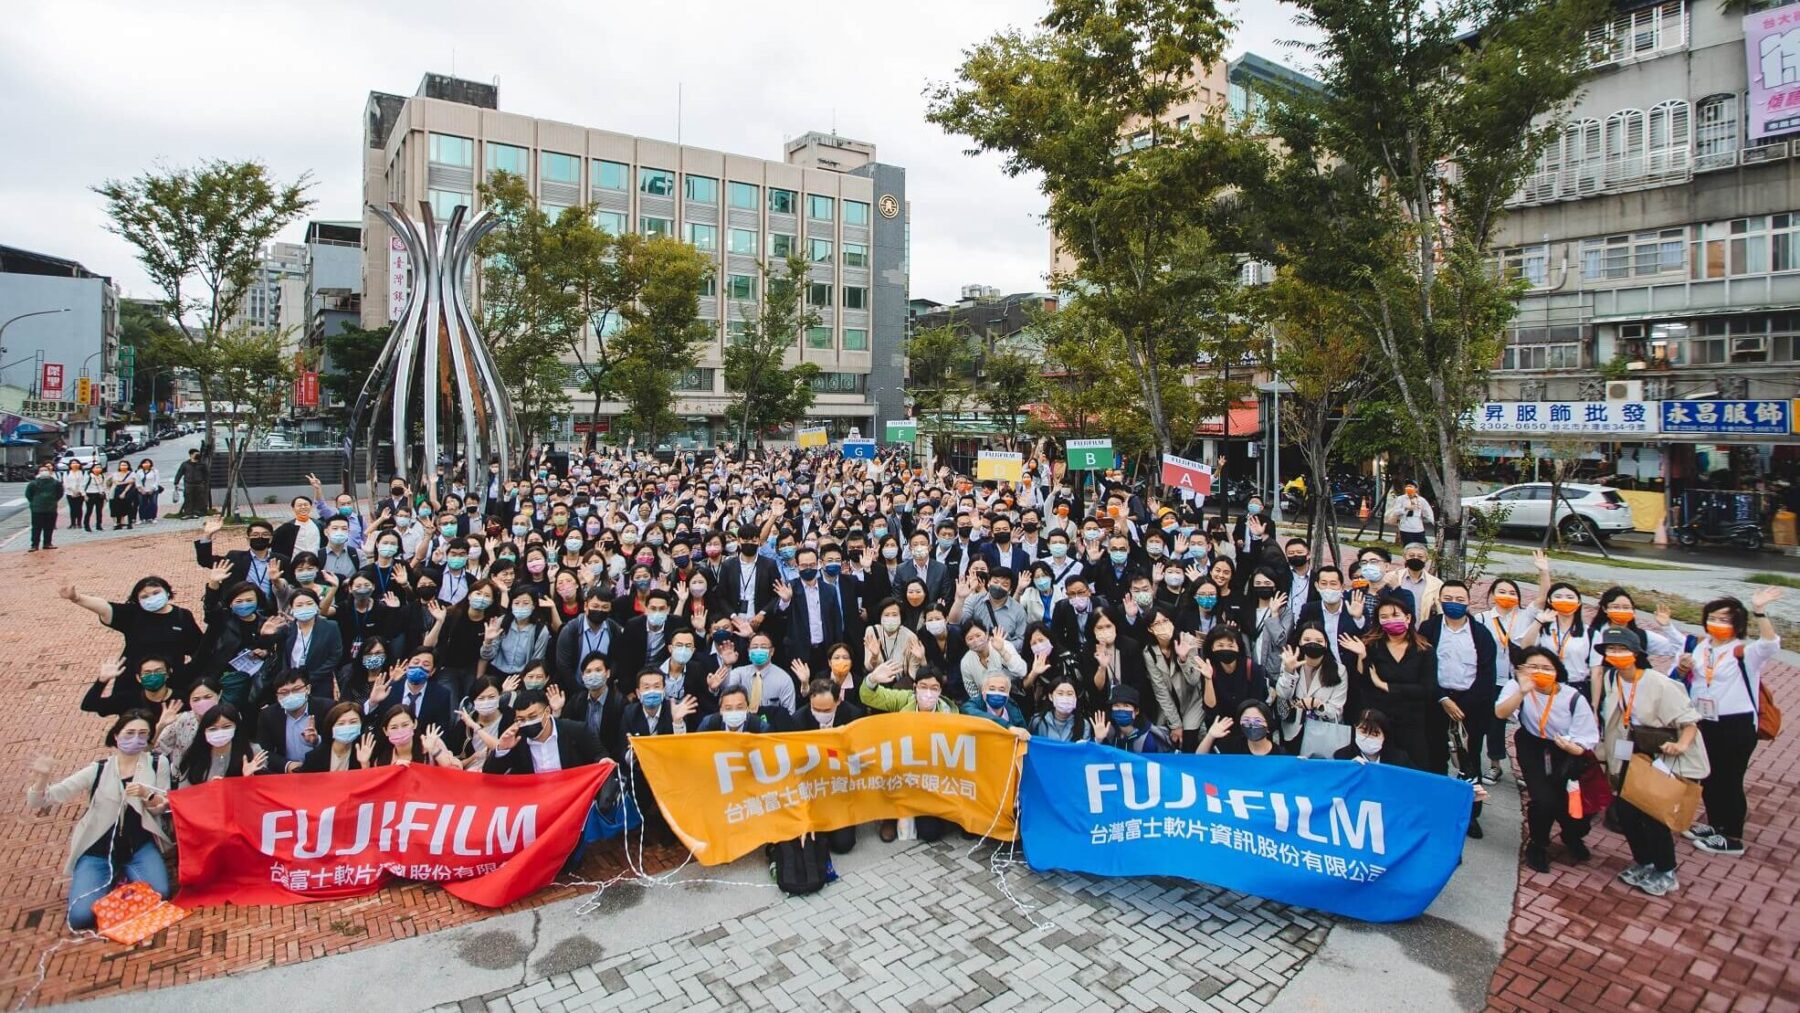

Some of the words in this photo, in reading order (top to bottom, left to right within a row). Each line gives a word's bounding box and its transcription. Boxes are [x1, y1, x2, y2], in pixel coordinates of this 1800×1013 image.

[1667, 402, 1784, 425] 永昌服飾
[898, 429, 905, 439] F
[854, 447, 864, 457] G
[1085, 452, 1097, 465] B
[1180, 472, 1193, 487] A
[714, 732, 977, 795] FUJIFILM
[1084, 762, 1386, 855] FUJIFILM
[260, 801, 539, 859] FUJIFILM
[1090, 817, 1387, 882] 台灣富士軟片資訊股份有限公司
